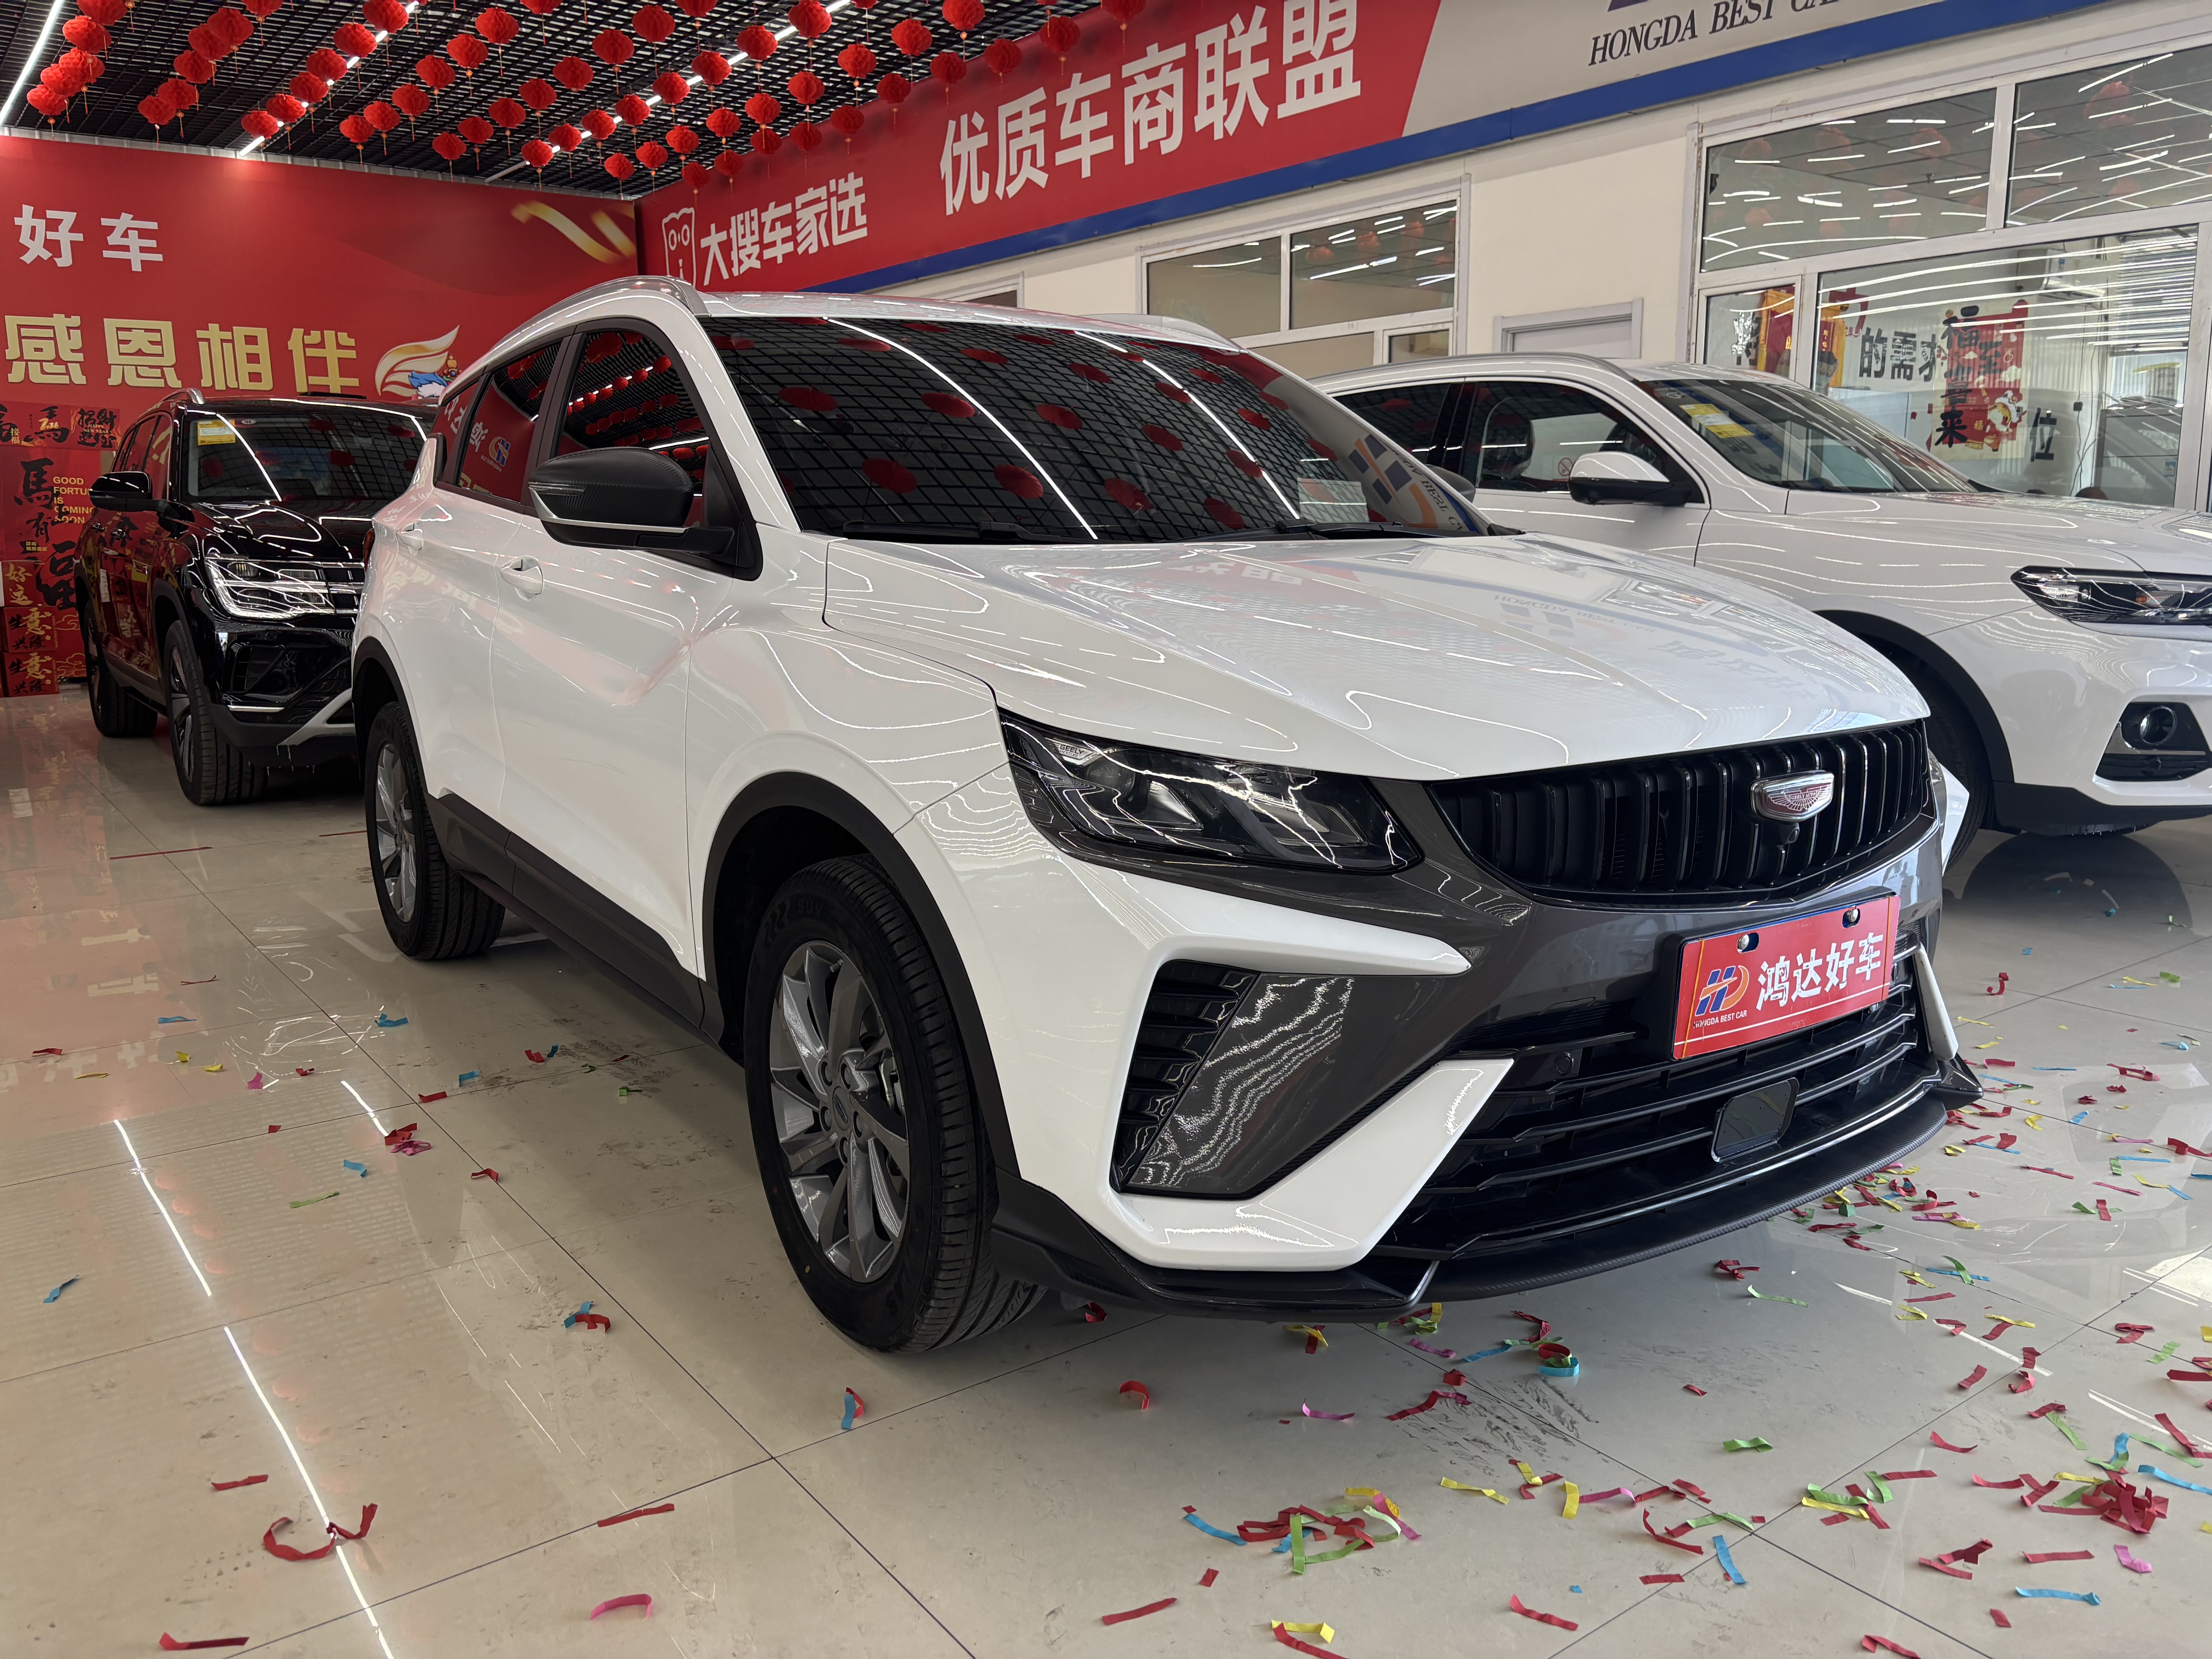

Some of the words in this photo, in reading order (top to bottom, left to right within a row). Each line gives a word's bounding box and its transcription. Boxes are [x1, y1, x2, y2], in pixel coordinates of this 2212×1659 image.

[1588, 9, 1698, 66] HONGDA
[1709, 0, 1774, 34] BEST
[940, 0, 1360, 216] 优质车商联盟
[14, 204, 163, 272] 好车
[700, 173, 868, 286] 大搜车家选
[5, 313, 360, 393] 感恩相伴
[2030, 407, 2057, 462] 位
[53, 476, 84, 485] GOOD
[53, 486, 89, 495] FORTU
[1060, 744, 1084, 755] GEELY
[797, 898, 824, 917] SUV
[1756, 932, 1883, 1010] 鸿达好车
[1693, 1017, 1719, 1029] HONGDA
[1720, 1013, 1735, 1023] BEST
[1736, 1010, 1747, 1019] CAR
